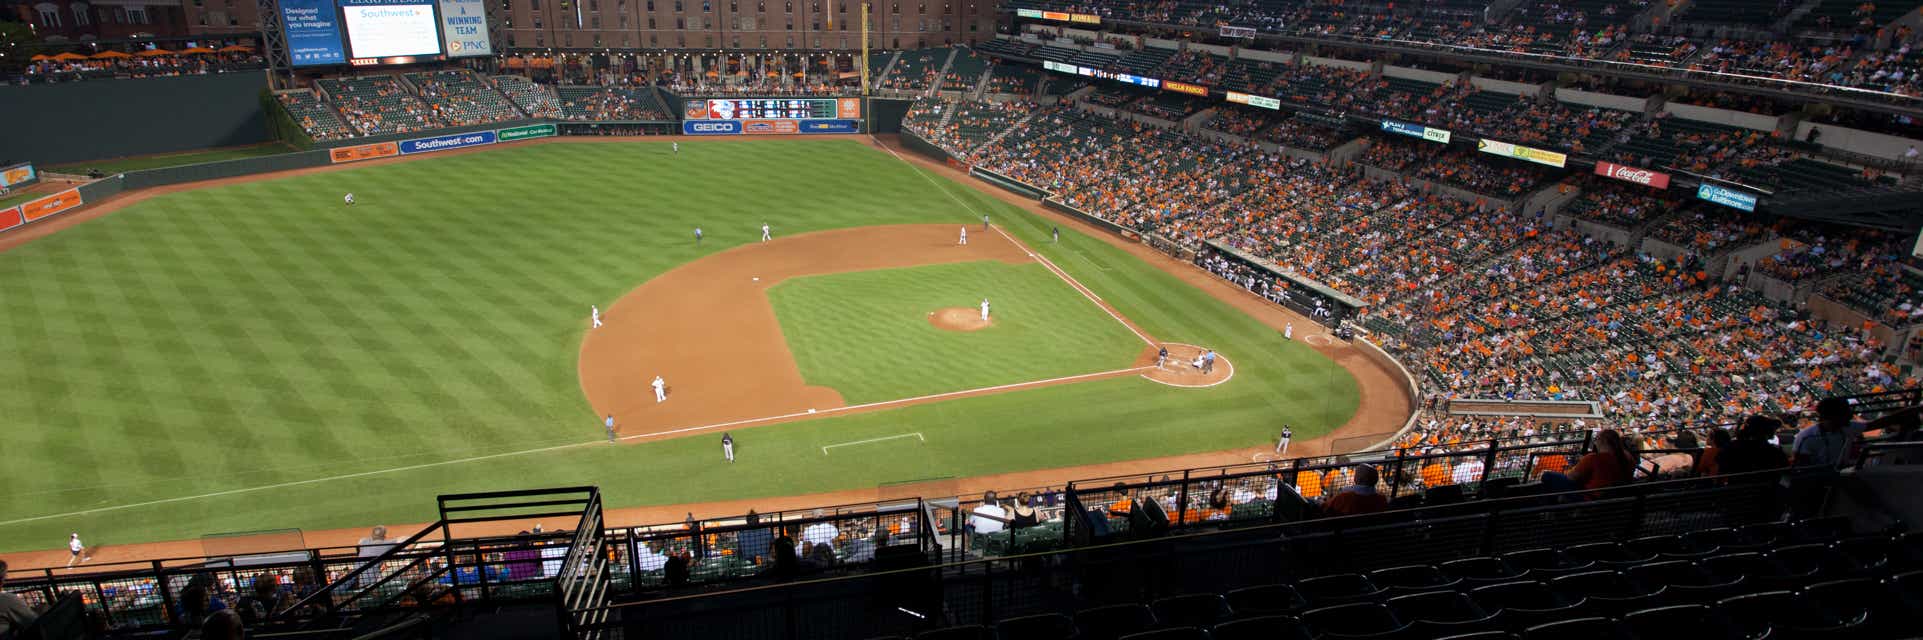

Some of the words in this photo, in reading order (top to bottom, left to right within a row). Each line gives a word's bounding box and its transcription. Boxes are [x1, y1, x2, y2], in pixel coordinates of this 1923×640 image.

[360, 8, 414, 18] Southwest
[447, 16, 482, 24] WINNING
[456, 26, 477, 34] TEAM
[463, 40, 487, 49] PNC
[1167, 81, 1186, 90] WELLS
[1186, 84, 1204, 94] FARGO
[693, 123, 733, 131] GEICO
